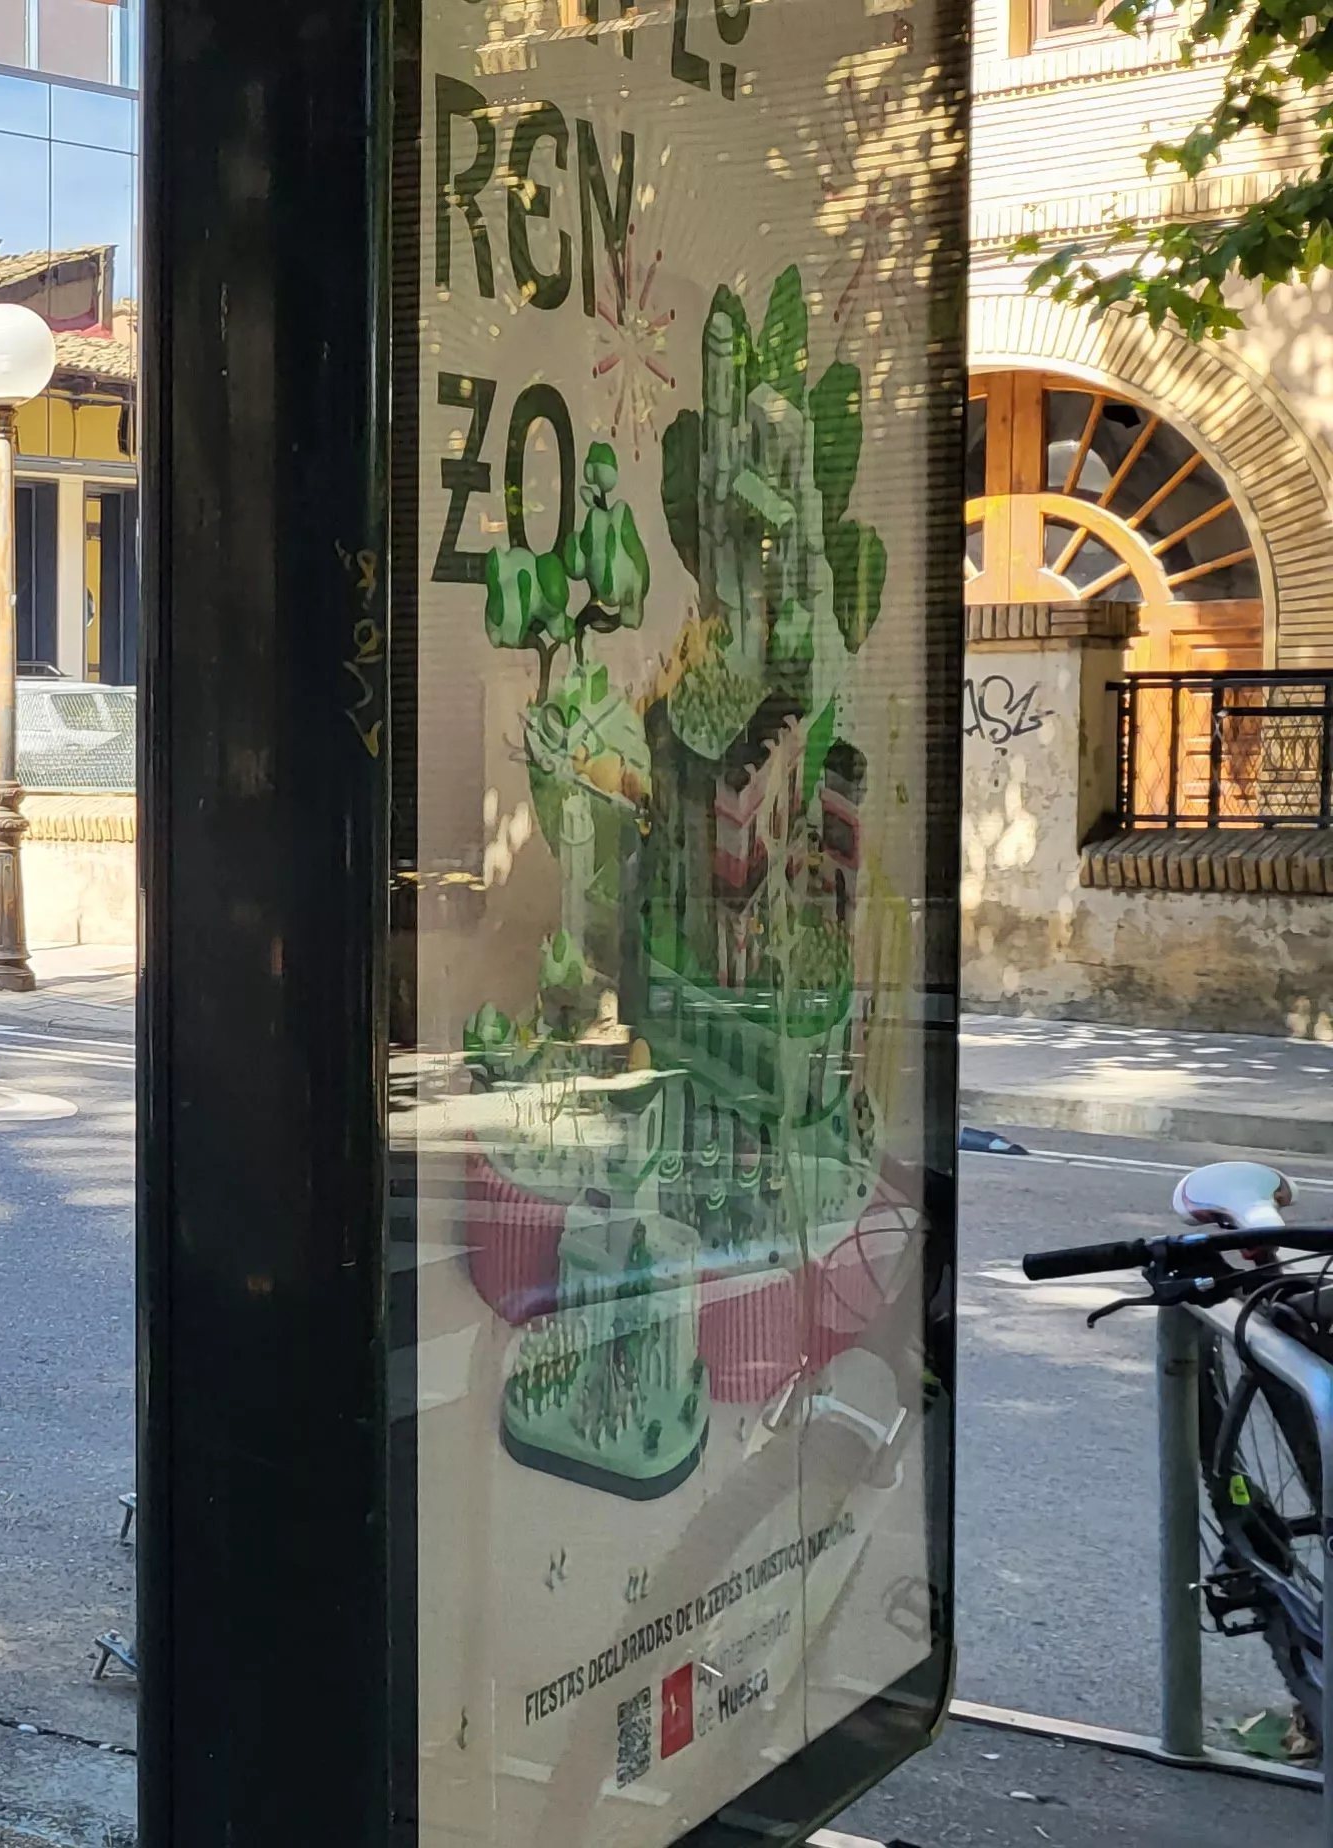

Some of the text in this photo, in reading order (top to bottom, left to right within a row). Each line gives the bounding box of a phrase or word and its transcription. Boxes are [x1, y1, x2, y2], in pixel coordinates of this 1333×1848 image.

[434, 74, 636, 326] REN
[525, 1665, 585, 1726] FIESTAS
[588, 1613, 673, 1690] DECLARADAS
[676, 1601, 694, 1637] DE
[719, 1667, 769, 1724] Huesca
